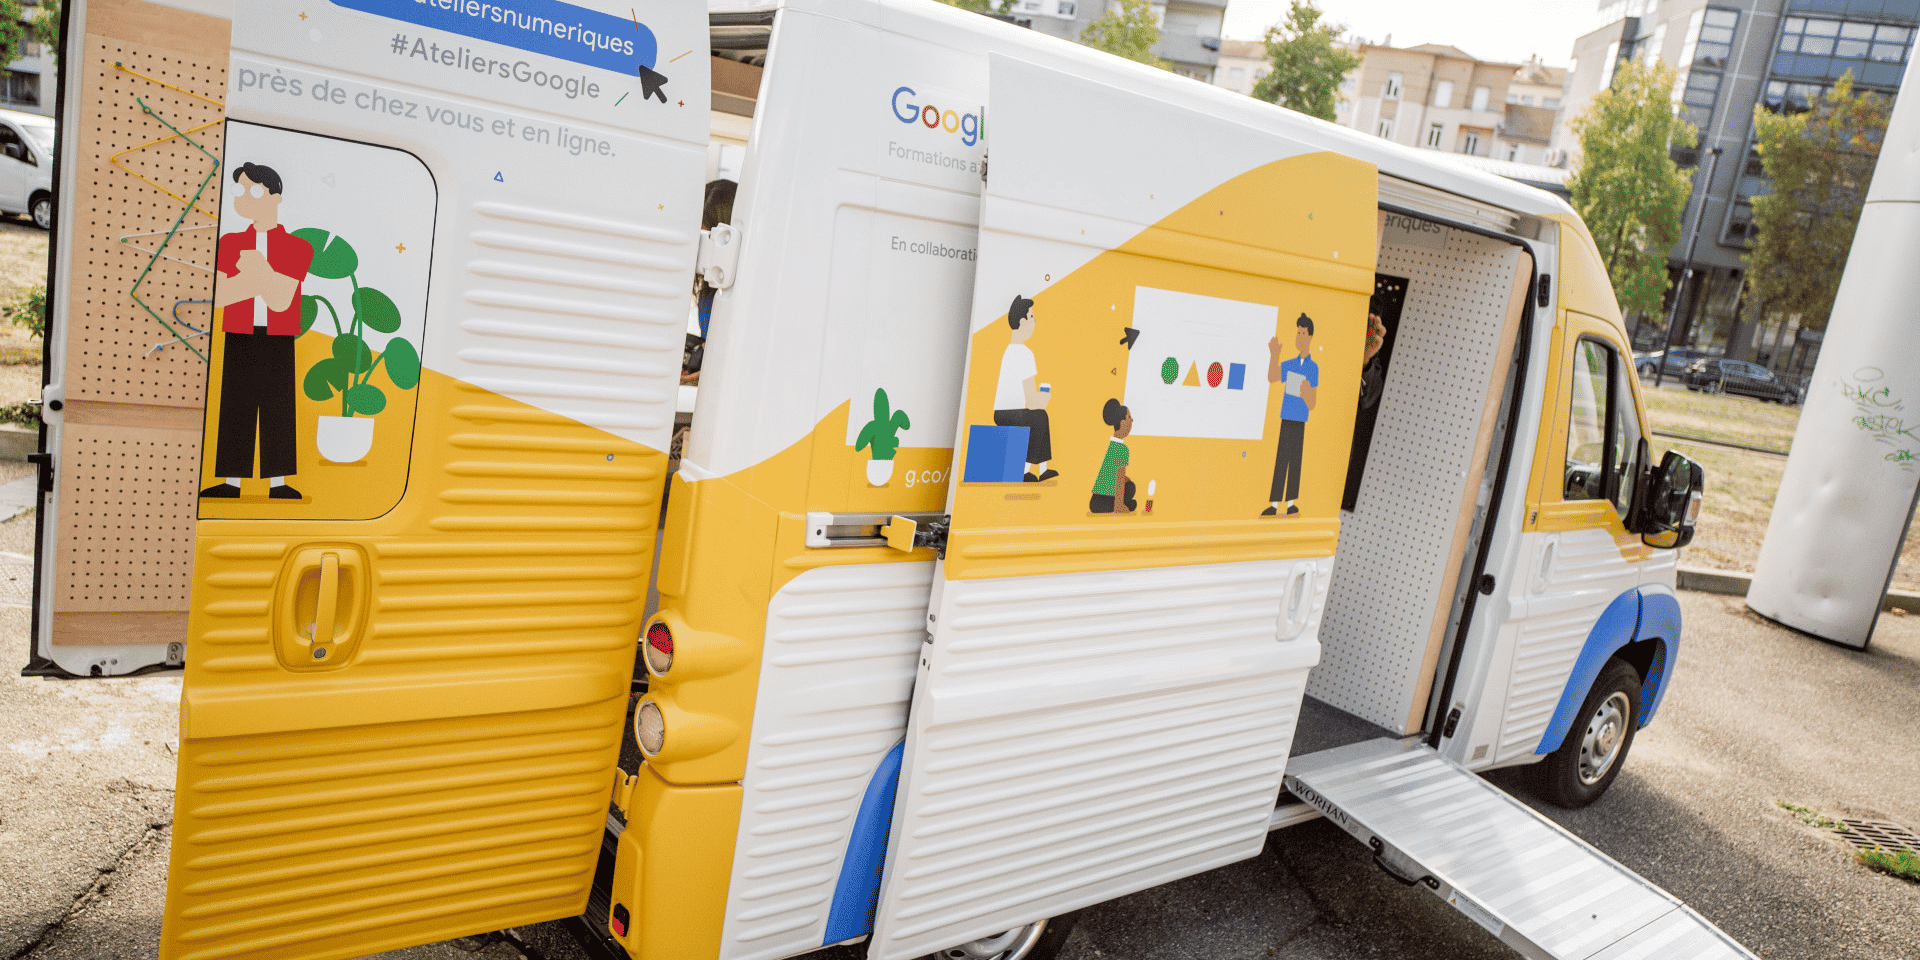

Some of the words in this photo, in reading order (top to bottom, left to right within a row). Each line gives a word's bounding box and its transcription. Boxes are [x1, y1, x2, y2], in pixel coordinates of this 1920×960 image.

[391, 33, 600, 99] #AteliersGoogle
[238, 68, 303, 97] près
[311, 79, 347, 105] de
[354, 89, 418, 119] chez
[425, 105, 484, 133] vous
[491, 118, 515, 138] et
[522, 125, 550, 145] en
[557, 127, 616, 157] ligne.
[888, 140, 967, 172] Formations
[969, 161, 981, 174] a
[891, 236, 907, 252] En
[910, 241, 978, 262] collaborati
[1295, 781, 1349, 824] WORHAN
